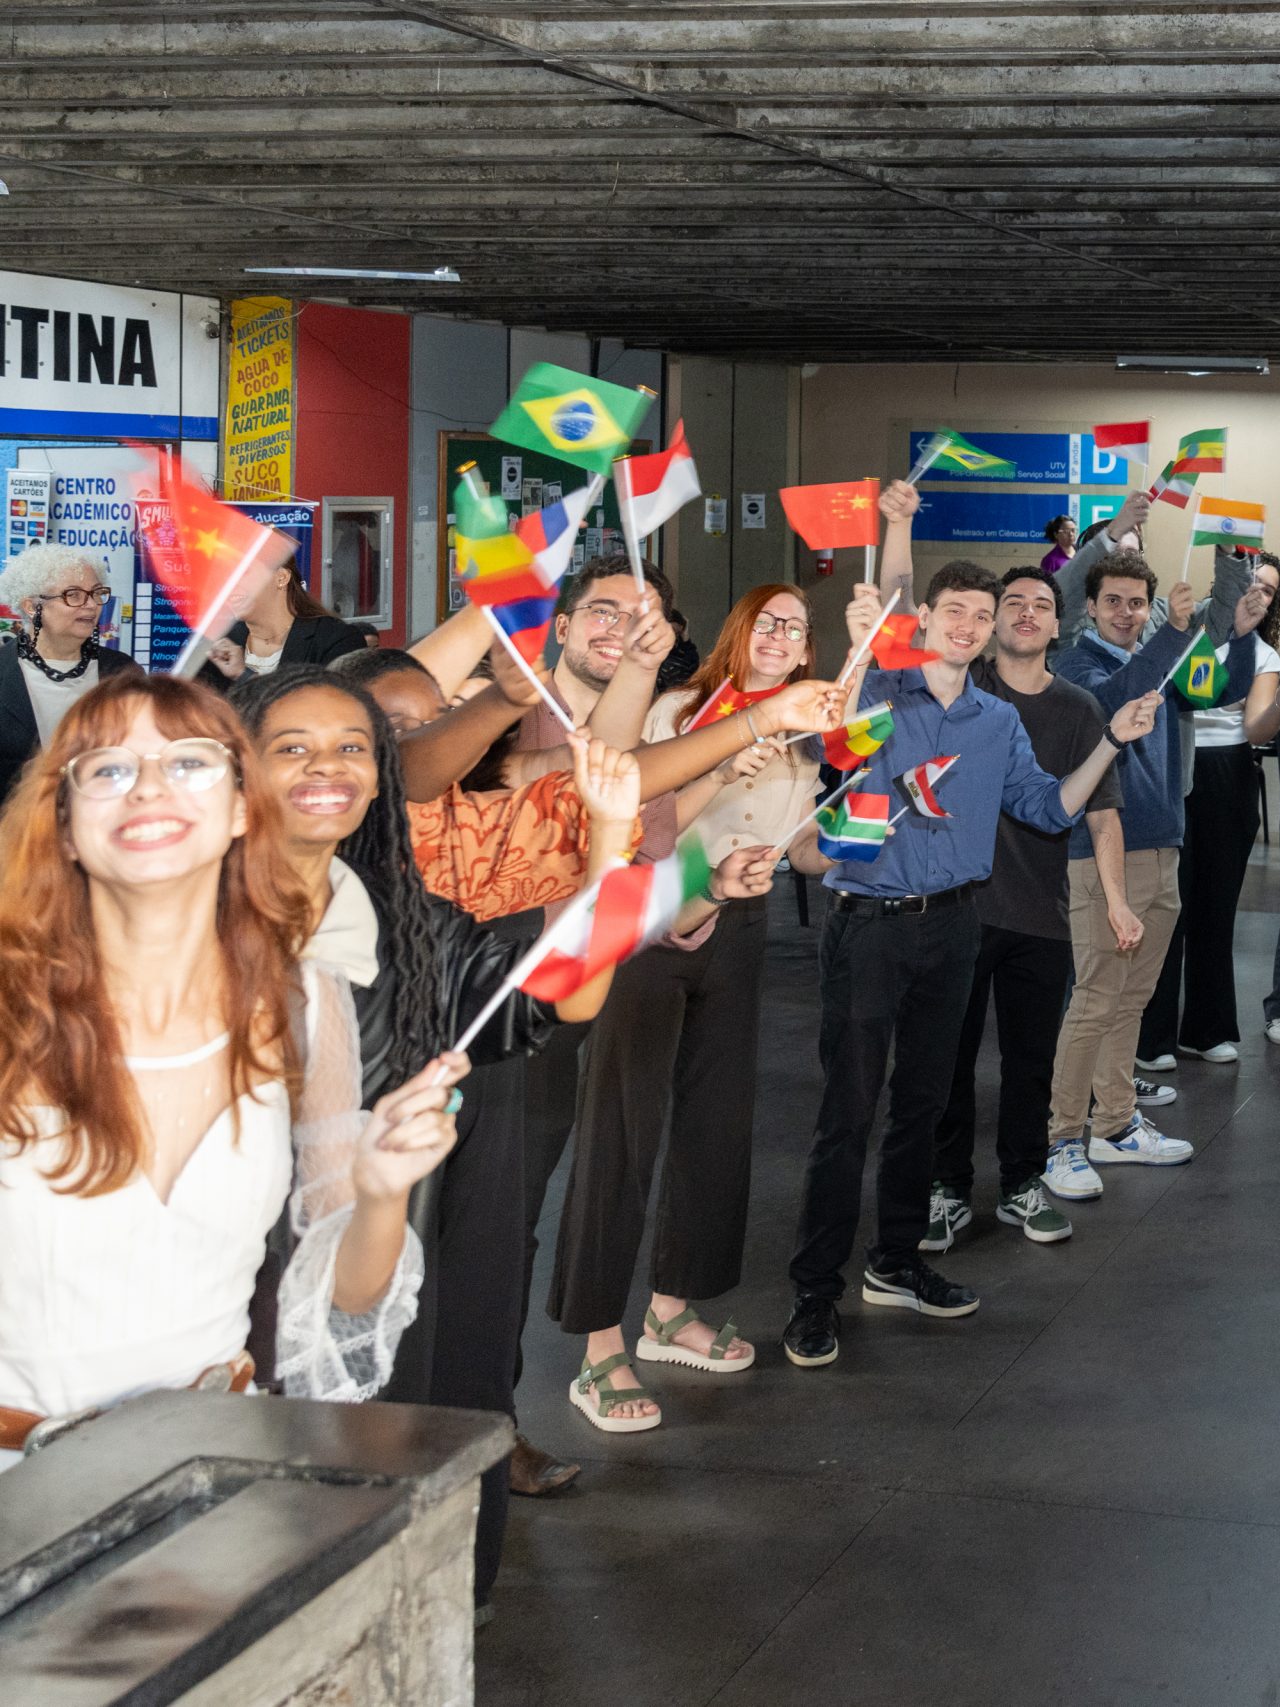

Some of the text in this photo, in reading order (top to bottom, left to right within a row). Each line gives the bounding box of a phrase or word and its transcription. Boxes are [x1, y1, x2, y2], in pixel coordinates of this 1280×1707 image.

[237, 322, 289, 358] TICKETS
[237, 348, 289, 384] AGUA DE
[244, 371, 279, 397] COCO
[231, 388, 290, 420] GUARANA
[232, 407, 290, 435] NATURAL
[229, 430, 291, 456] REFRIGERANTES
[238, 443, 287, 466] DIVERSOS
[1050, 462, 1066, 470] UTV
[1093, 444, 1117, 474] D
[10, 479, 48, 488] ACEITAMOS
[232, 460, 279, 484] SUCO
[1017, 470, 1043, 479] Serviço
[1045, 470, 1066, 479] Social
[13, 487, 44, 496] CARTÕES
[55, 477, 116, 495] CENTRO
[248, 510, 310, 524] ducação
[998, 530, 1028, 538] Ciências
[153, 639, 181, 647] Carne
